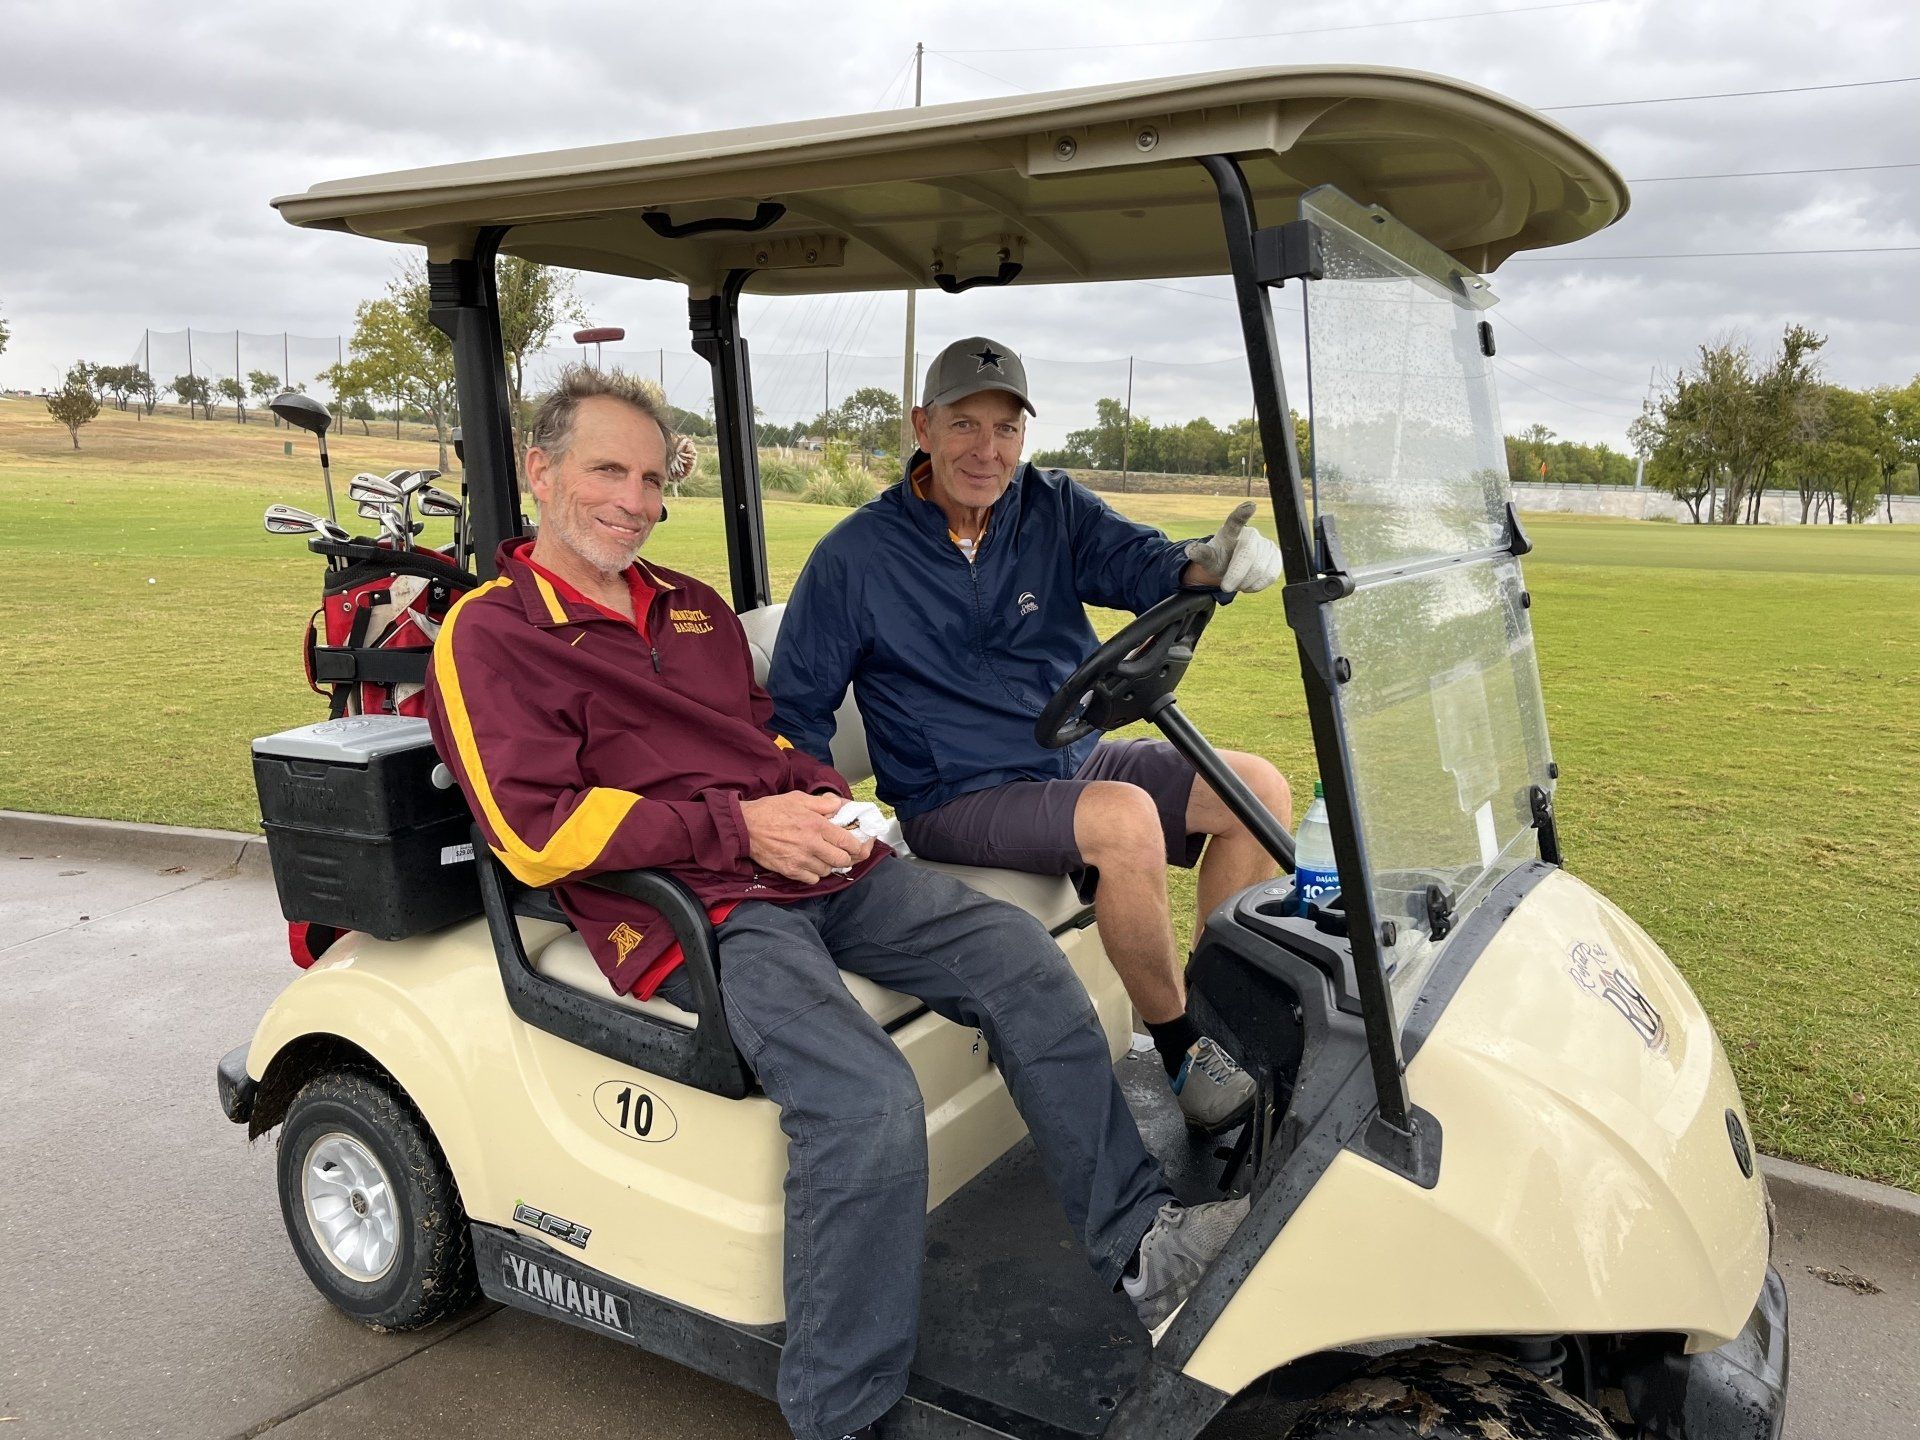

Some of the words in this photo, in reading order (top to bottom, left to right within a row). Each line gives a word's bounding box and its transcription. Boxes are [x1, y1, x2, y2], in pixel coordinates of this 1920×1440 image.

[673, 622, 714, 634] BASEBALL
[1303, 884, 1341, 899] 10
[616, 1086, 654, 1137] 10
[513, 1204, 592, 1244] EFI
[509, 1253, 623, 1329] YAMAHA
